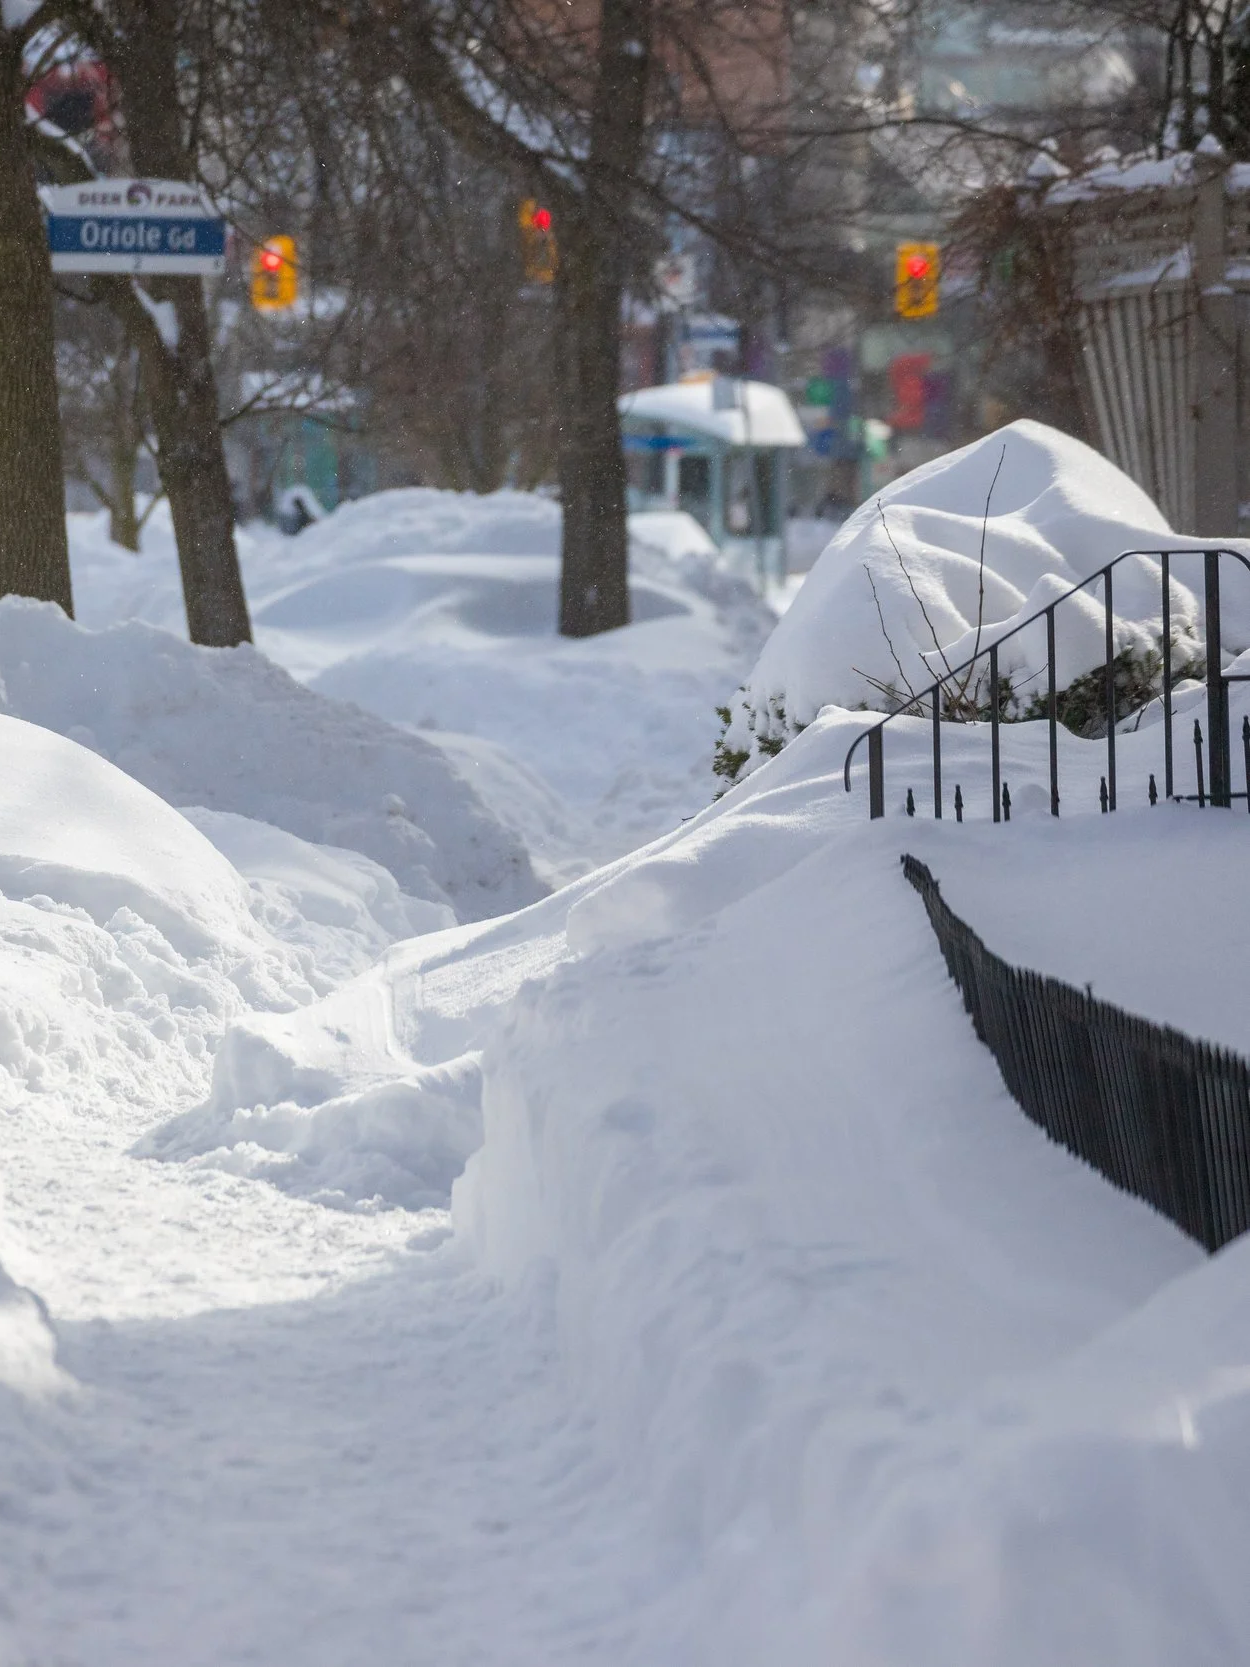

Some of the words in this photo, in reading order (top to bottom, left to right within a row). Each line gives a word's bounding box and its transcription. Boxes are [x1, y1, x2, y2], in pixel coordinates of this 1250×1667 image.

[78, 192, 123, 207] DEER
[155, 193, 202, 208] PARK
[80, 220, 162, 249] Oriole
[167, 226, 197, 249] Gd
